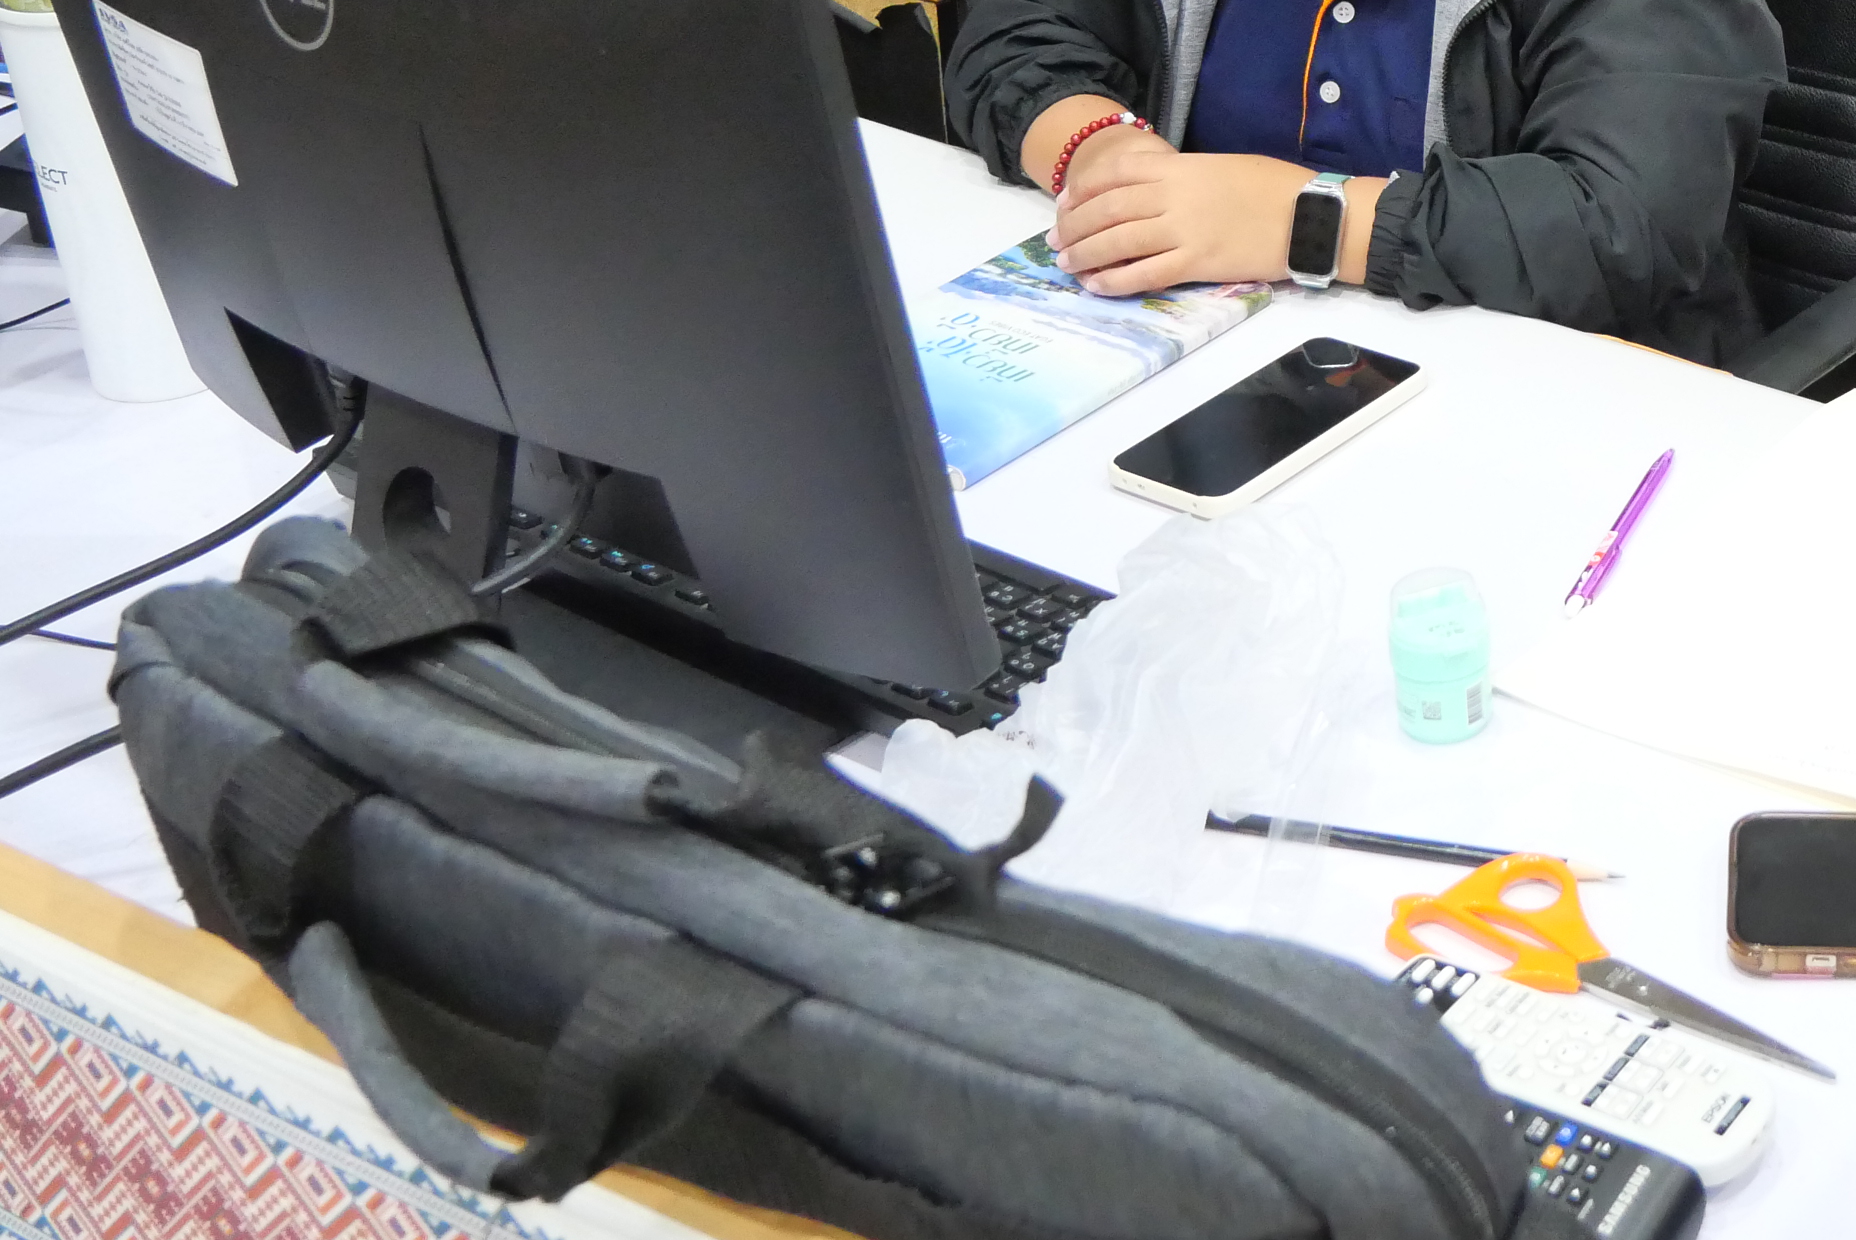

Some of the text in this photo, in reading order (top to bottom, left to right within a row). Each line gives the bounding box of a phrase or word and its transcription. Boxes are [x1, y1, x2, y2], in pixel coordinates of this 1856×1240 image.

[33, 160, 68, 186] LECT
[1701, 1093, 1730, 1123] EPSON
[1597, 1164, 1651, 1233] SAMSUNG
